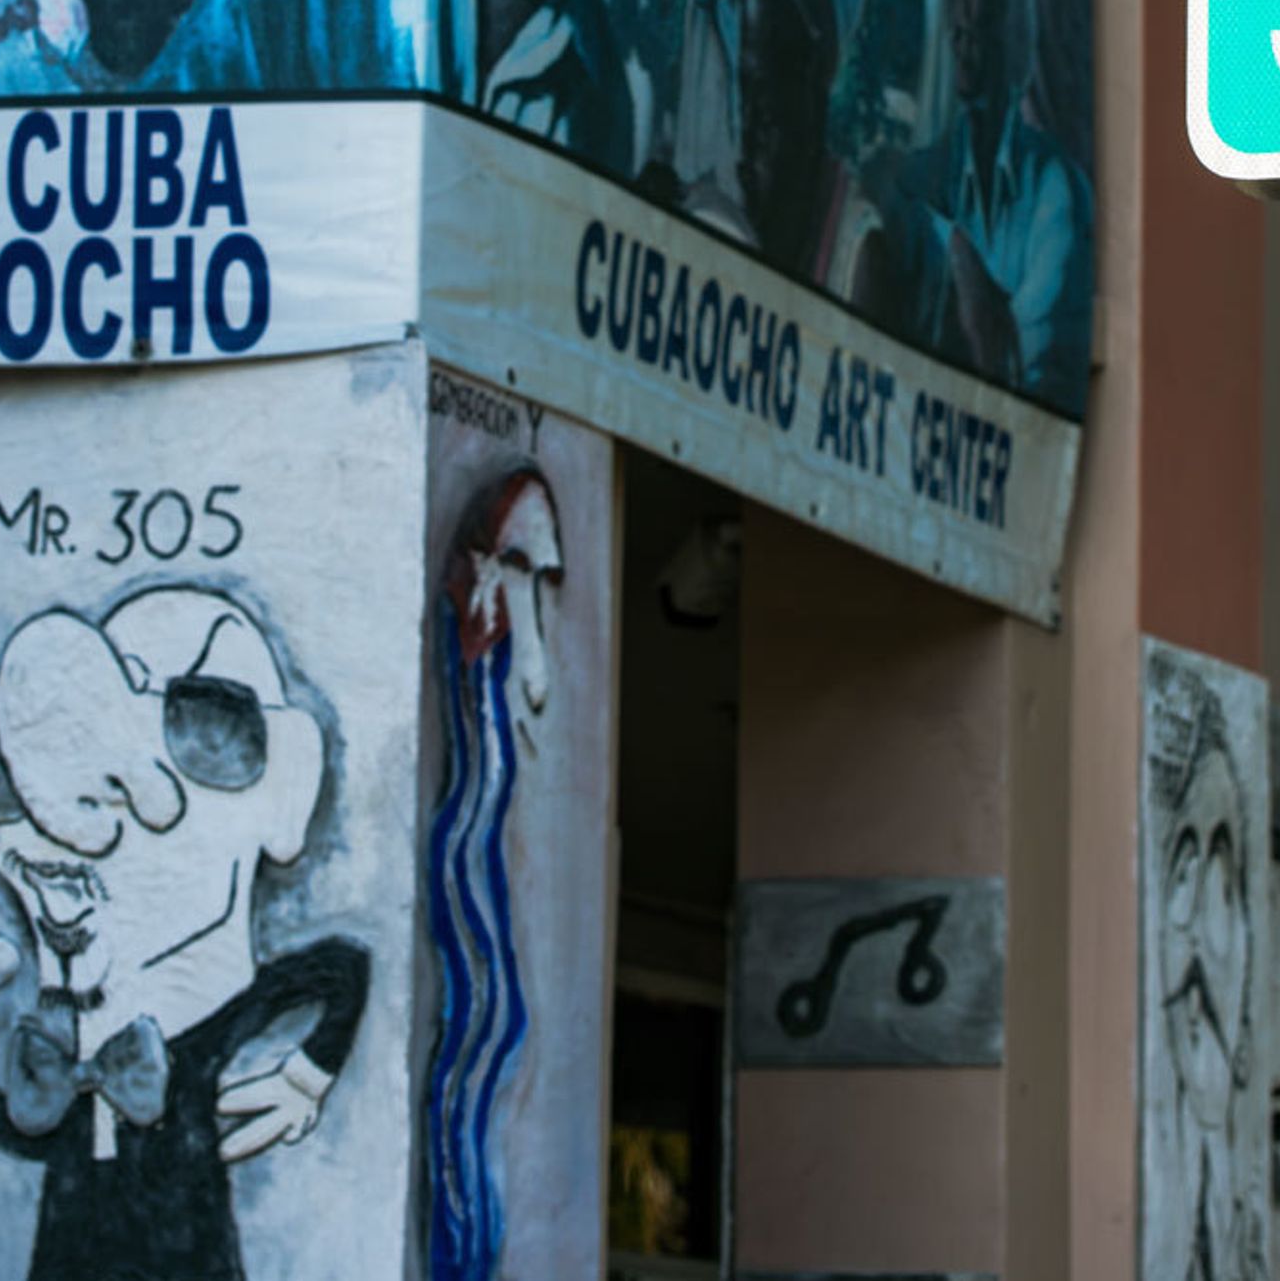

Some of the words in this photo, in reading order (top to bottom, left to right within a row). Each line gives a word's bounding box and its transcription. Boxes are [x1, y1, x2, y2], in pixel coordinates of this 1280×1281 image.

[6, 106, 249, 235] CUBA
[575, 220, 802, 431] CUBAOCHO
[816, 347, 895, 478] ART
[909, 389, 1013, 531] CENTER
[95, 485, 244, 565] 305
